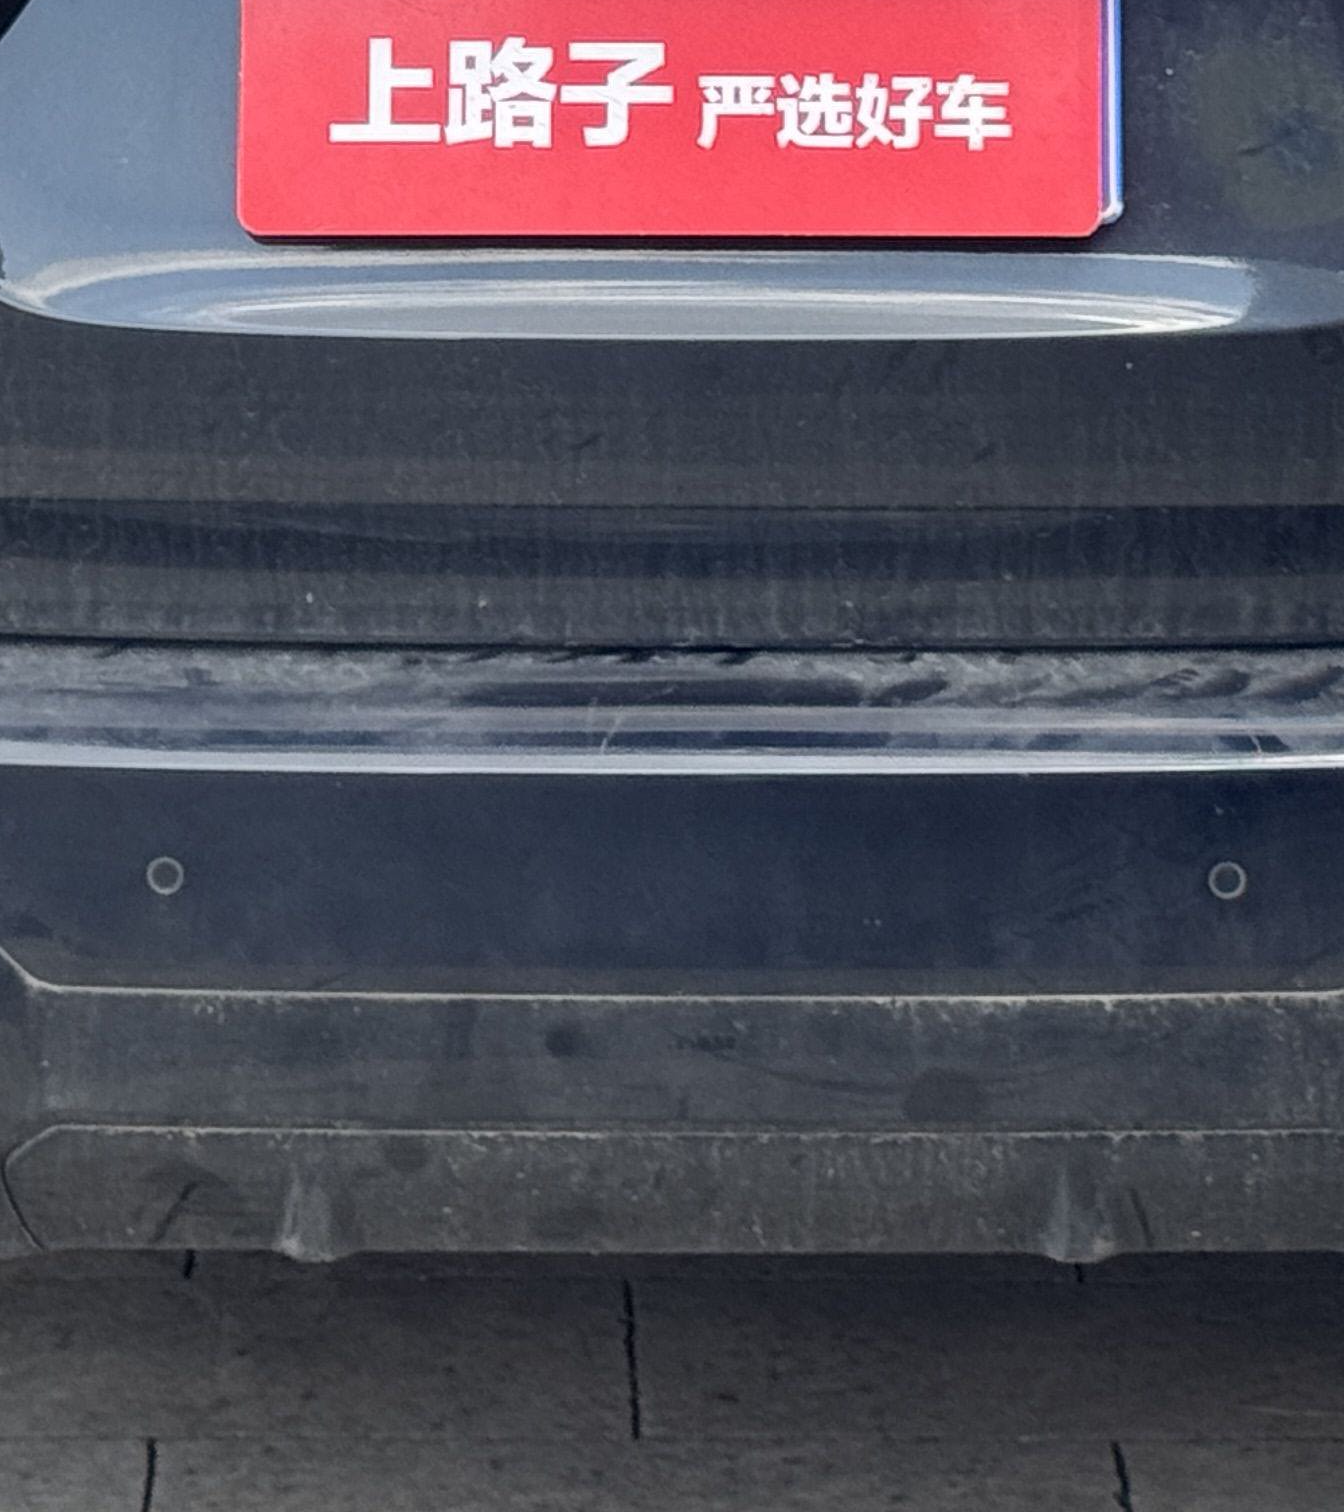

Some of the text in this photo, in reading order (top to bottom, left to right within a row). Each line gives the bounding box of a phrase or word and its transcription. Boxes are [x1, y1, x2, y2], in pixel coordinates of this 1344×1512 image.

[329, 35, 1014, 152] 上路子 严选好车
